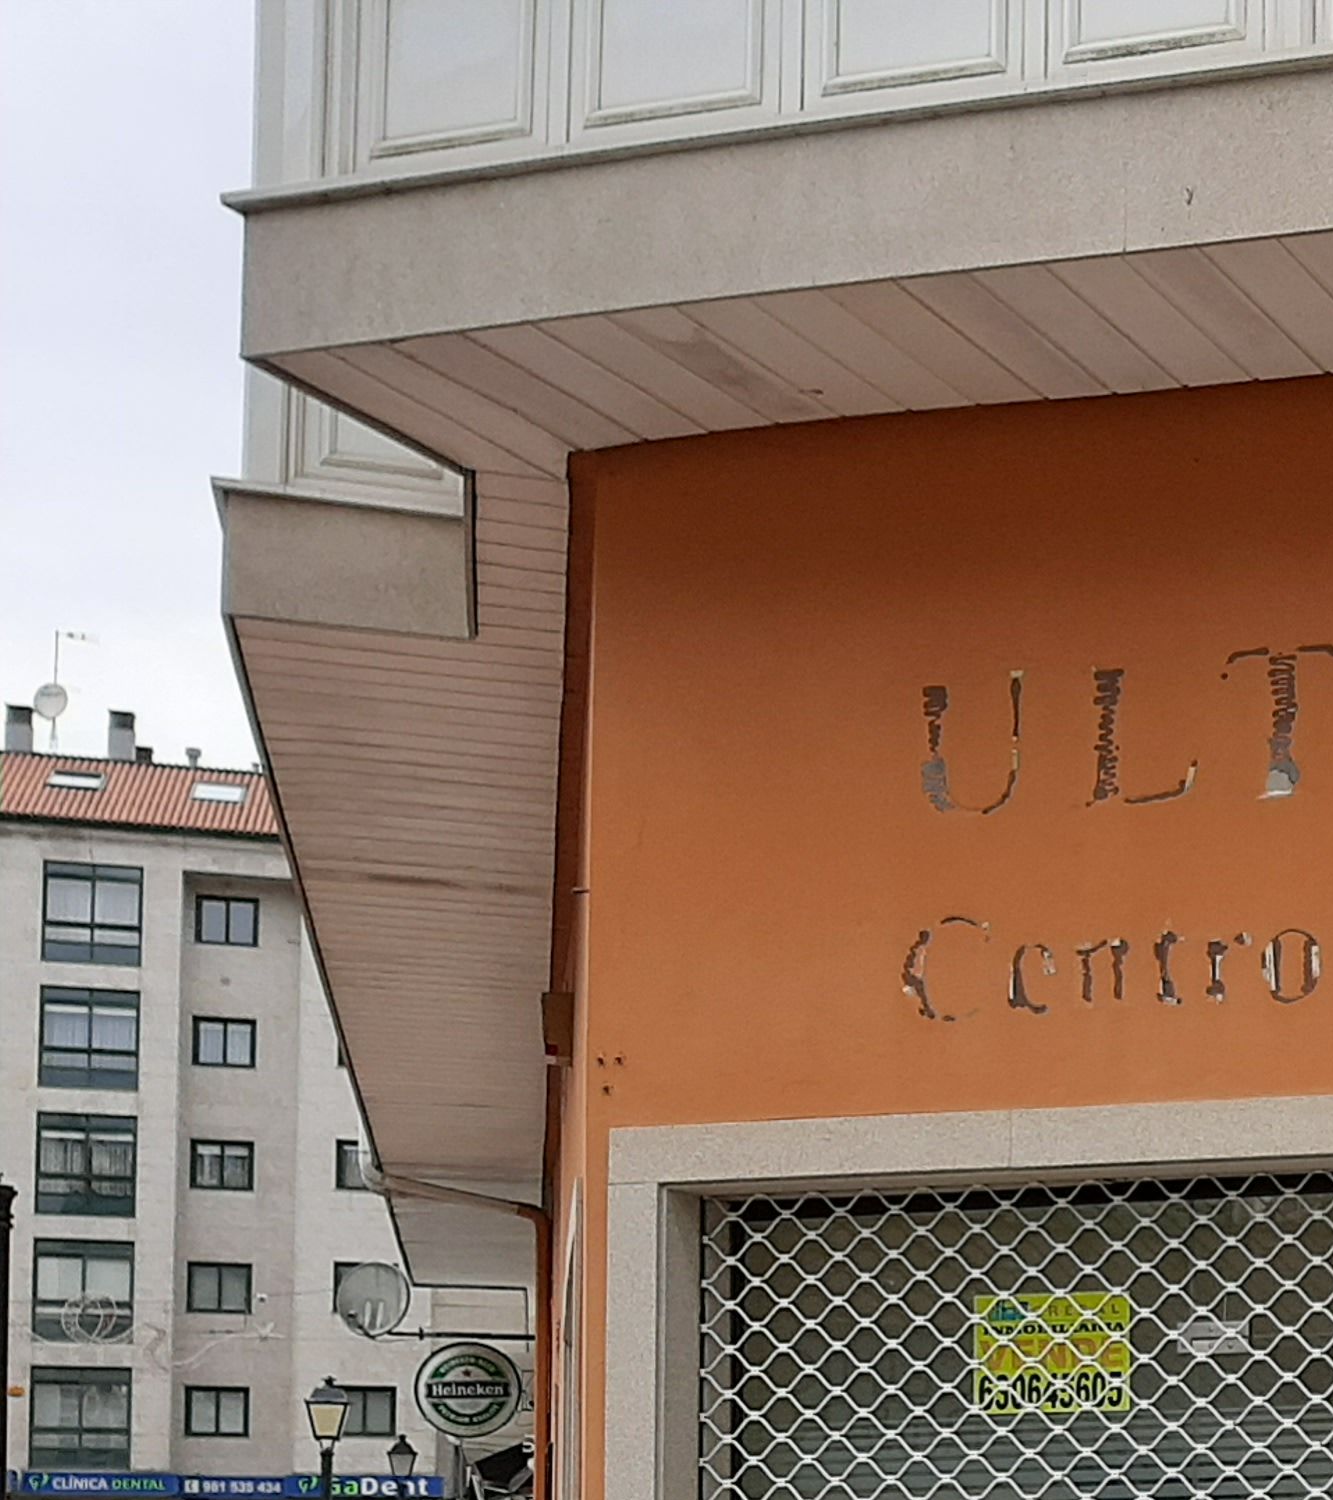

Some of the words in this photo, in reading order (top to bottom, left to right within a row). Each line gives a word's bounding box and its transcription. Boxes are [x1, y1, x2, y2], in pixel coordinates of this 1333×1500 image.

[902, 915, 1321, 1022] Centro
[432, 1382, 504, 1397] Heineken
[52, 1473, 108, 1490] CLÍNICA
[112, 1478, 166, 1490] DENTAL
